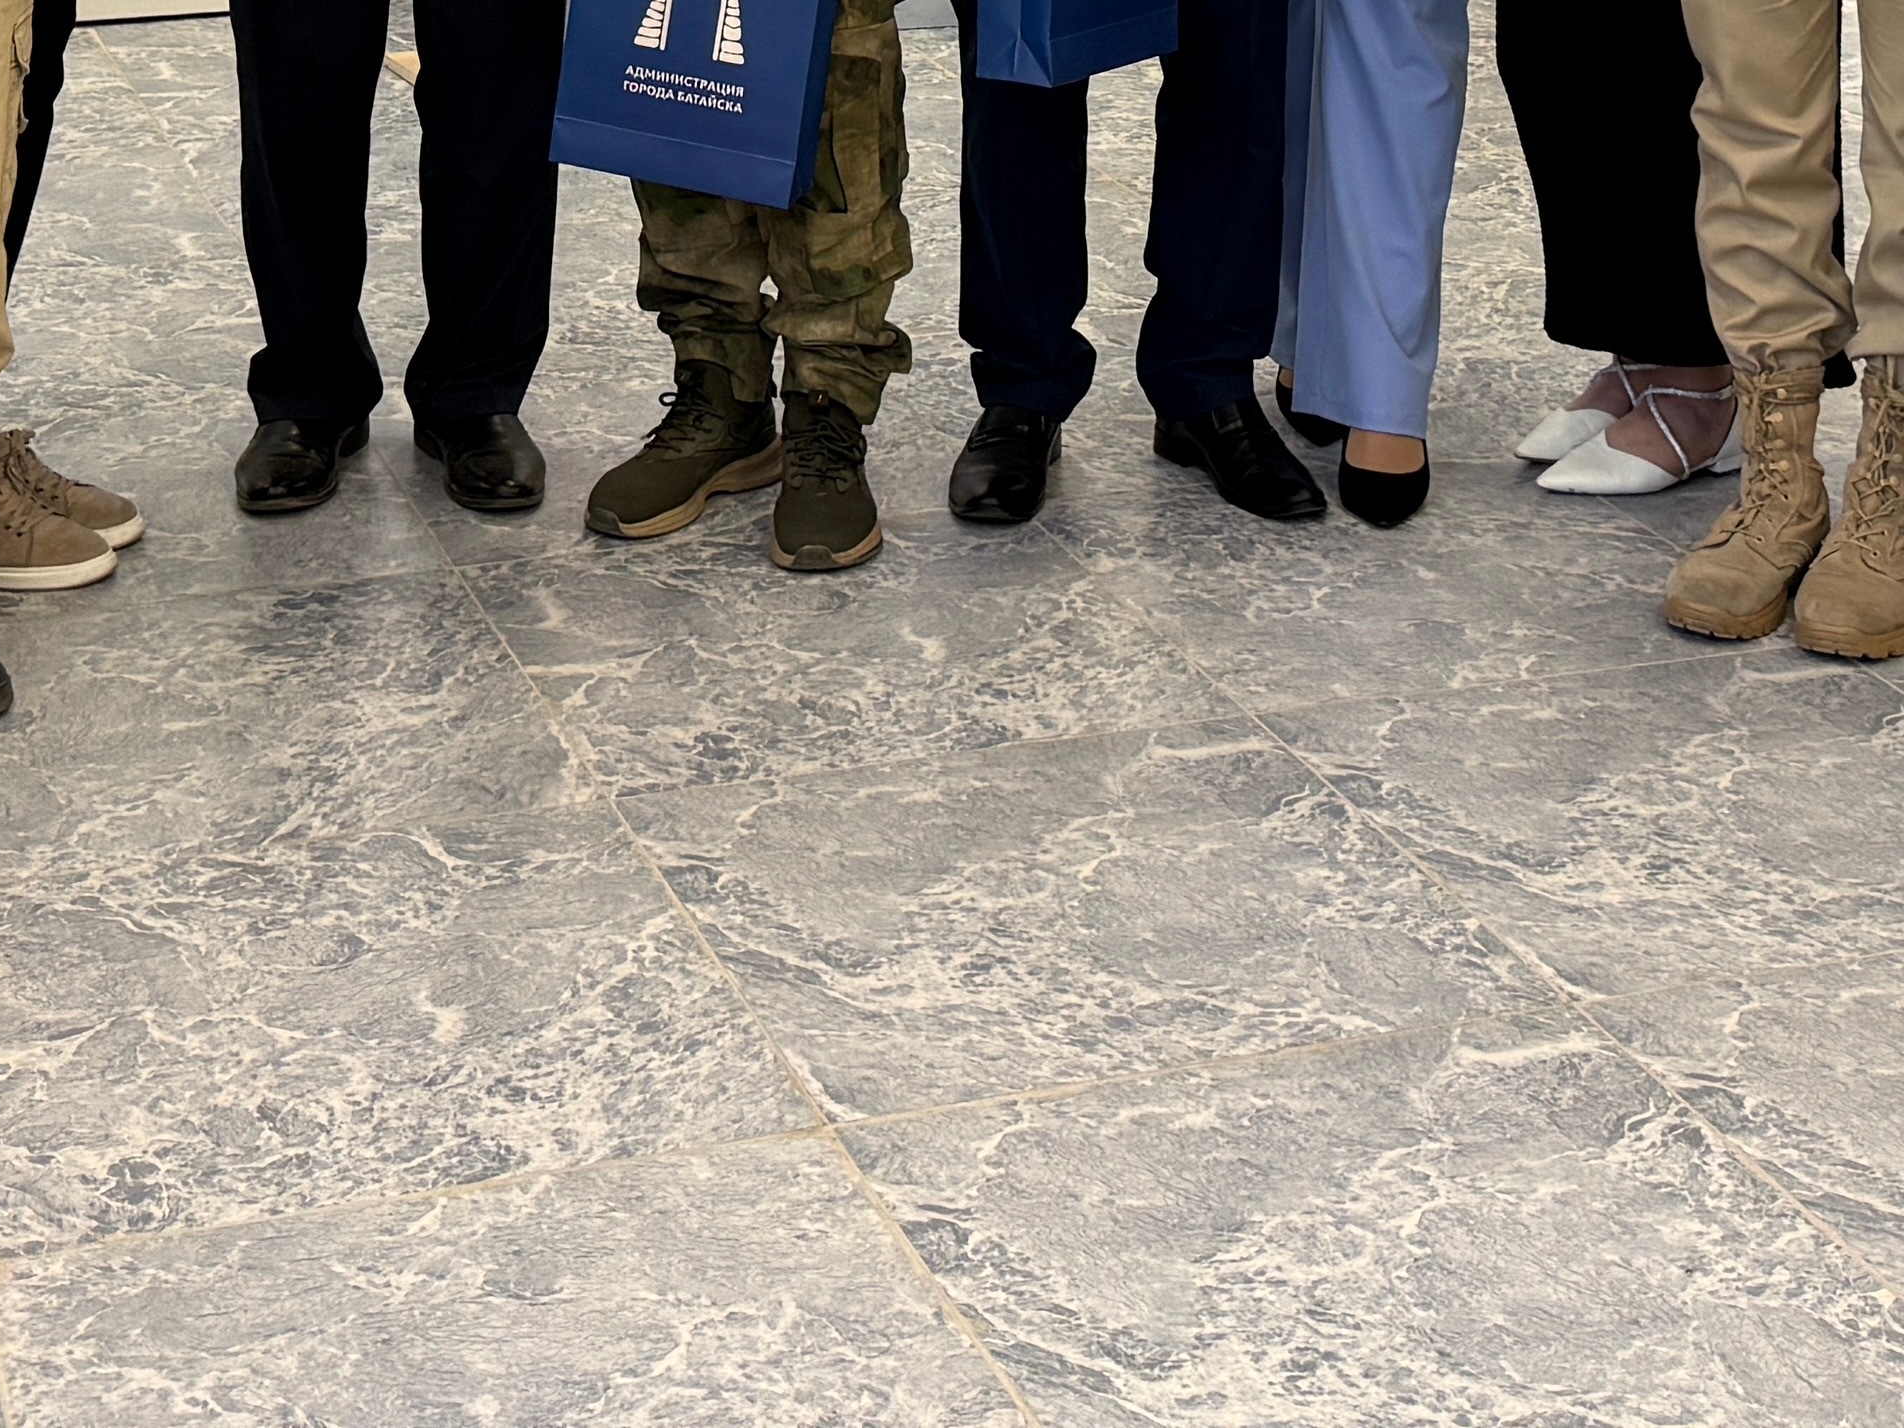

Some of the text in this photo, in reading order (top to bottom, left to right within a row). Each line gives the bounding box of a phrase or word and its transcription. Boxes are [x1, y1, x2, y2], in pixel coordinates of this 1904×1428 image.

[622, 79, 744, 114] ГОРОДА БАТАЙСКА
[624, 64, 745, 98] АДМИНИСТРАЦИЯ
